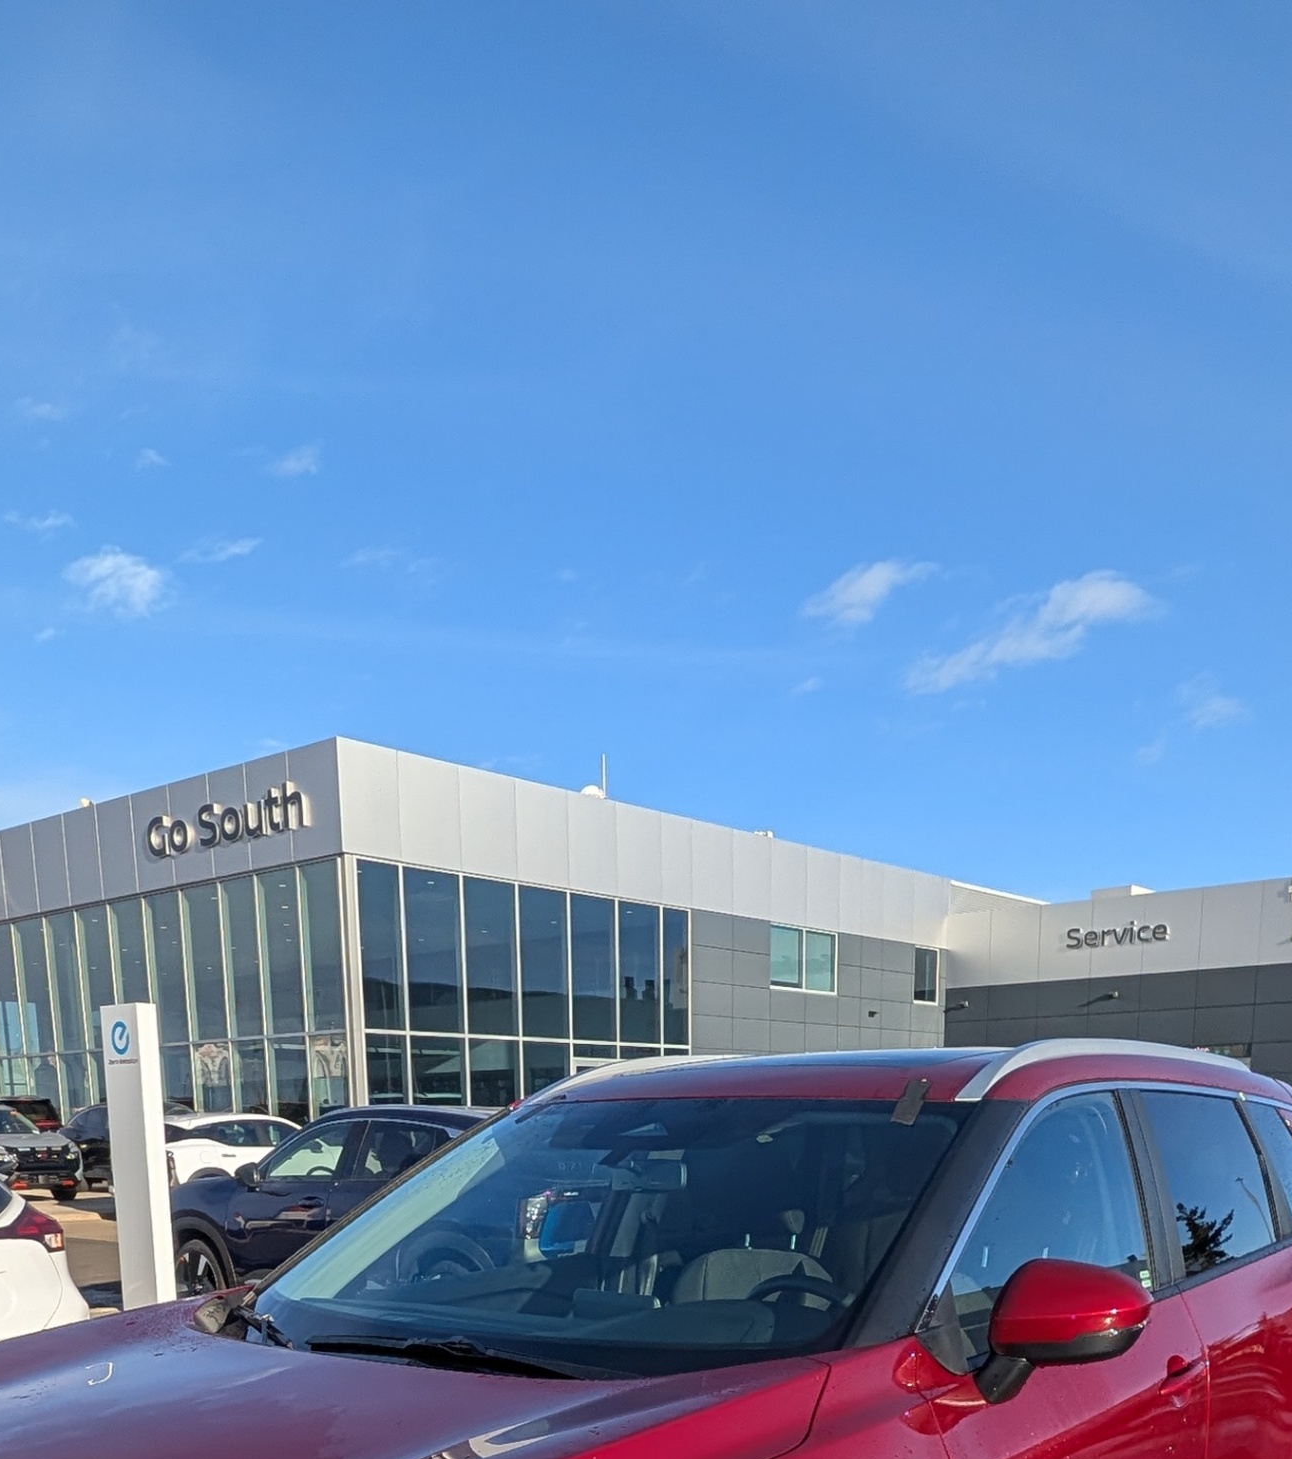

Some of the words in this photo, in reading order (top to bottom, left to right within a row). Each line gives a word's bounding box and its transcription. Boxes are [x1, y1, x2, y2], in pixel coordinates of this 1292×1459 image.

[146, 815, 192, 858] Go
[199, 780, 311, 849] South
[1065, 920, 1171, 949] Service
